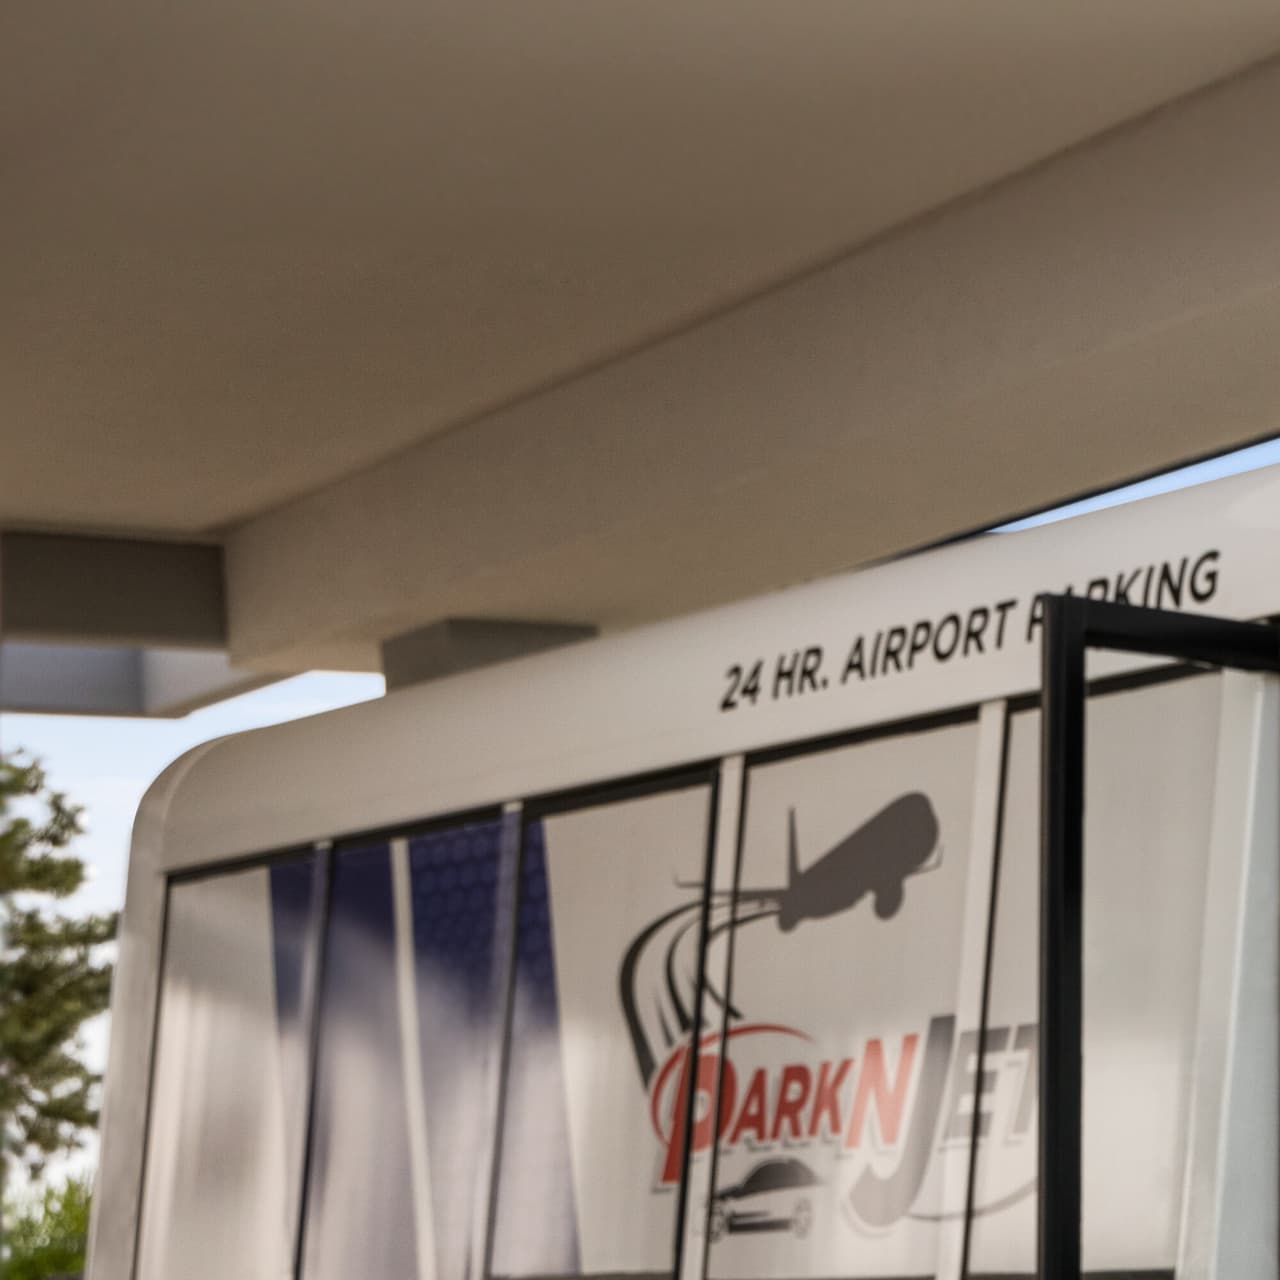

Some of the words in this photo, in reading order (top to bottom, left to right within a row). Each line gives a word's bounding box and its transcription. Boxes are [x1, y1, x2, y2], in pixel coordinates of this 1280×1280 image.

[720, 659, 764, 712] 24
[772, 645, 829, 700] HR.
[841, 600, 1016, 685] AIRPORT
[1026, 550, 1220, 643] PKING
